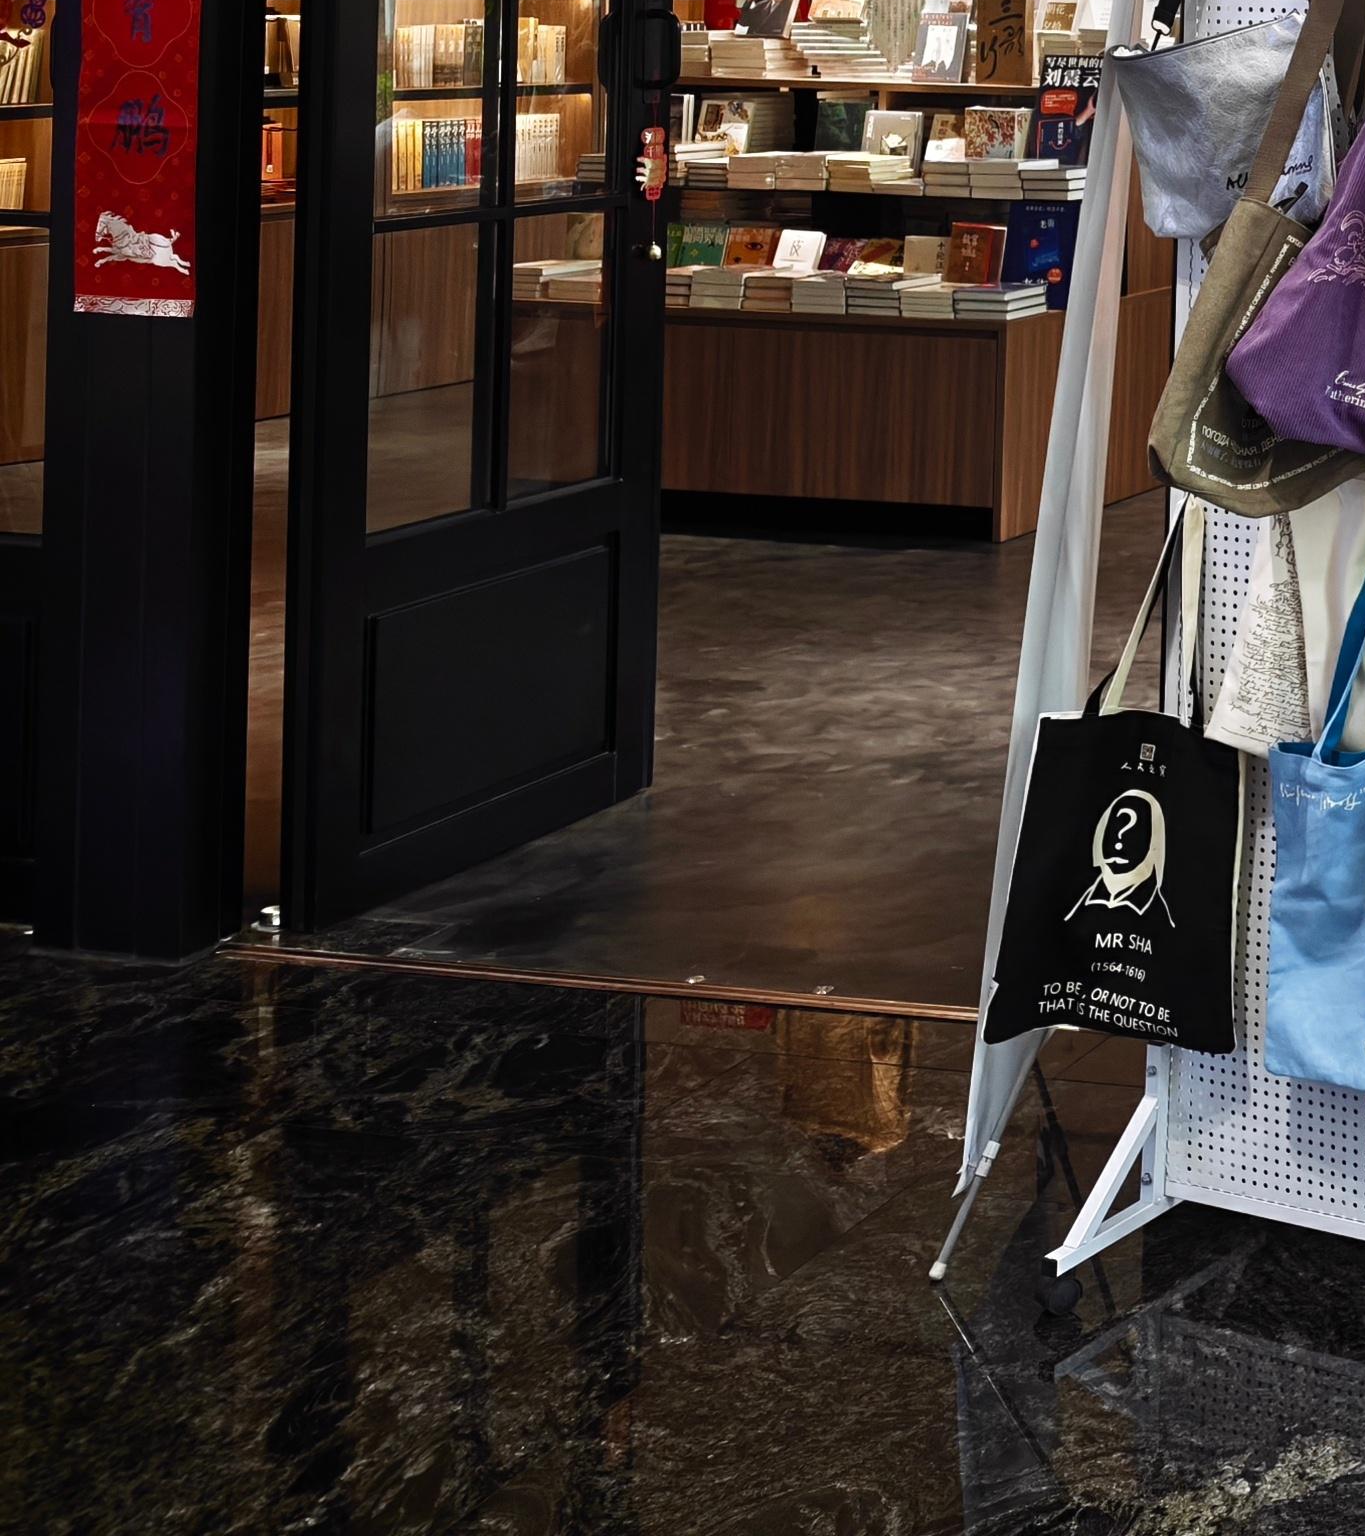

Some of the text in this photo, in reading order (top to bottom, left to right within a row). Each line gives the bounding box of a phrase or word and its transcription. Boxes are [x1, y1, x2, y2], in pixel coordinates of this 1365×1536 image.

[1046, 56, 1103, 68] 写尽世间的
[1042, 68, 1100, 87] 刘震云
[1095, 933, 1153, 955] MR SHA
[1043, 982, 1061, 996] TO
[1091, 987, 1109, 1004] OR
[1110, 992, 1136, 1012] NOT
[1138, 1000, 1157, 1017] TO
[1157, 1007, 1171, 1023] BE
[1038, 998, 1178, 1038] THAT IS THE QUESTION
